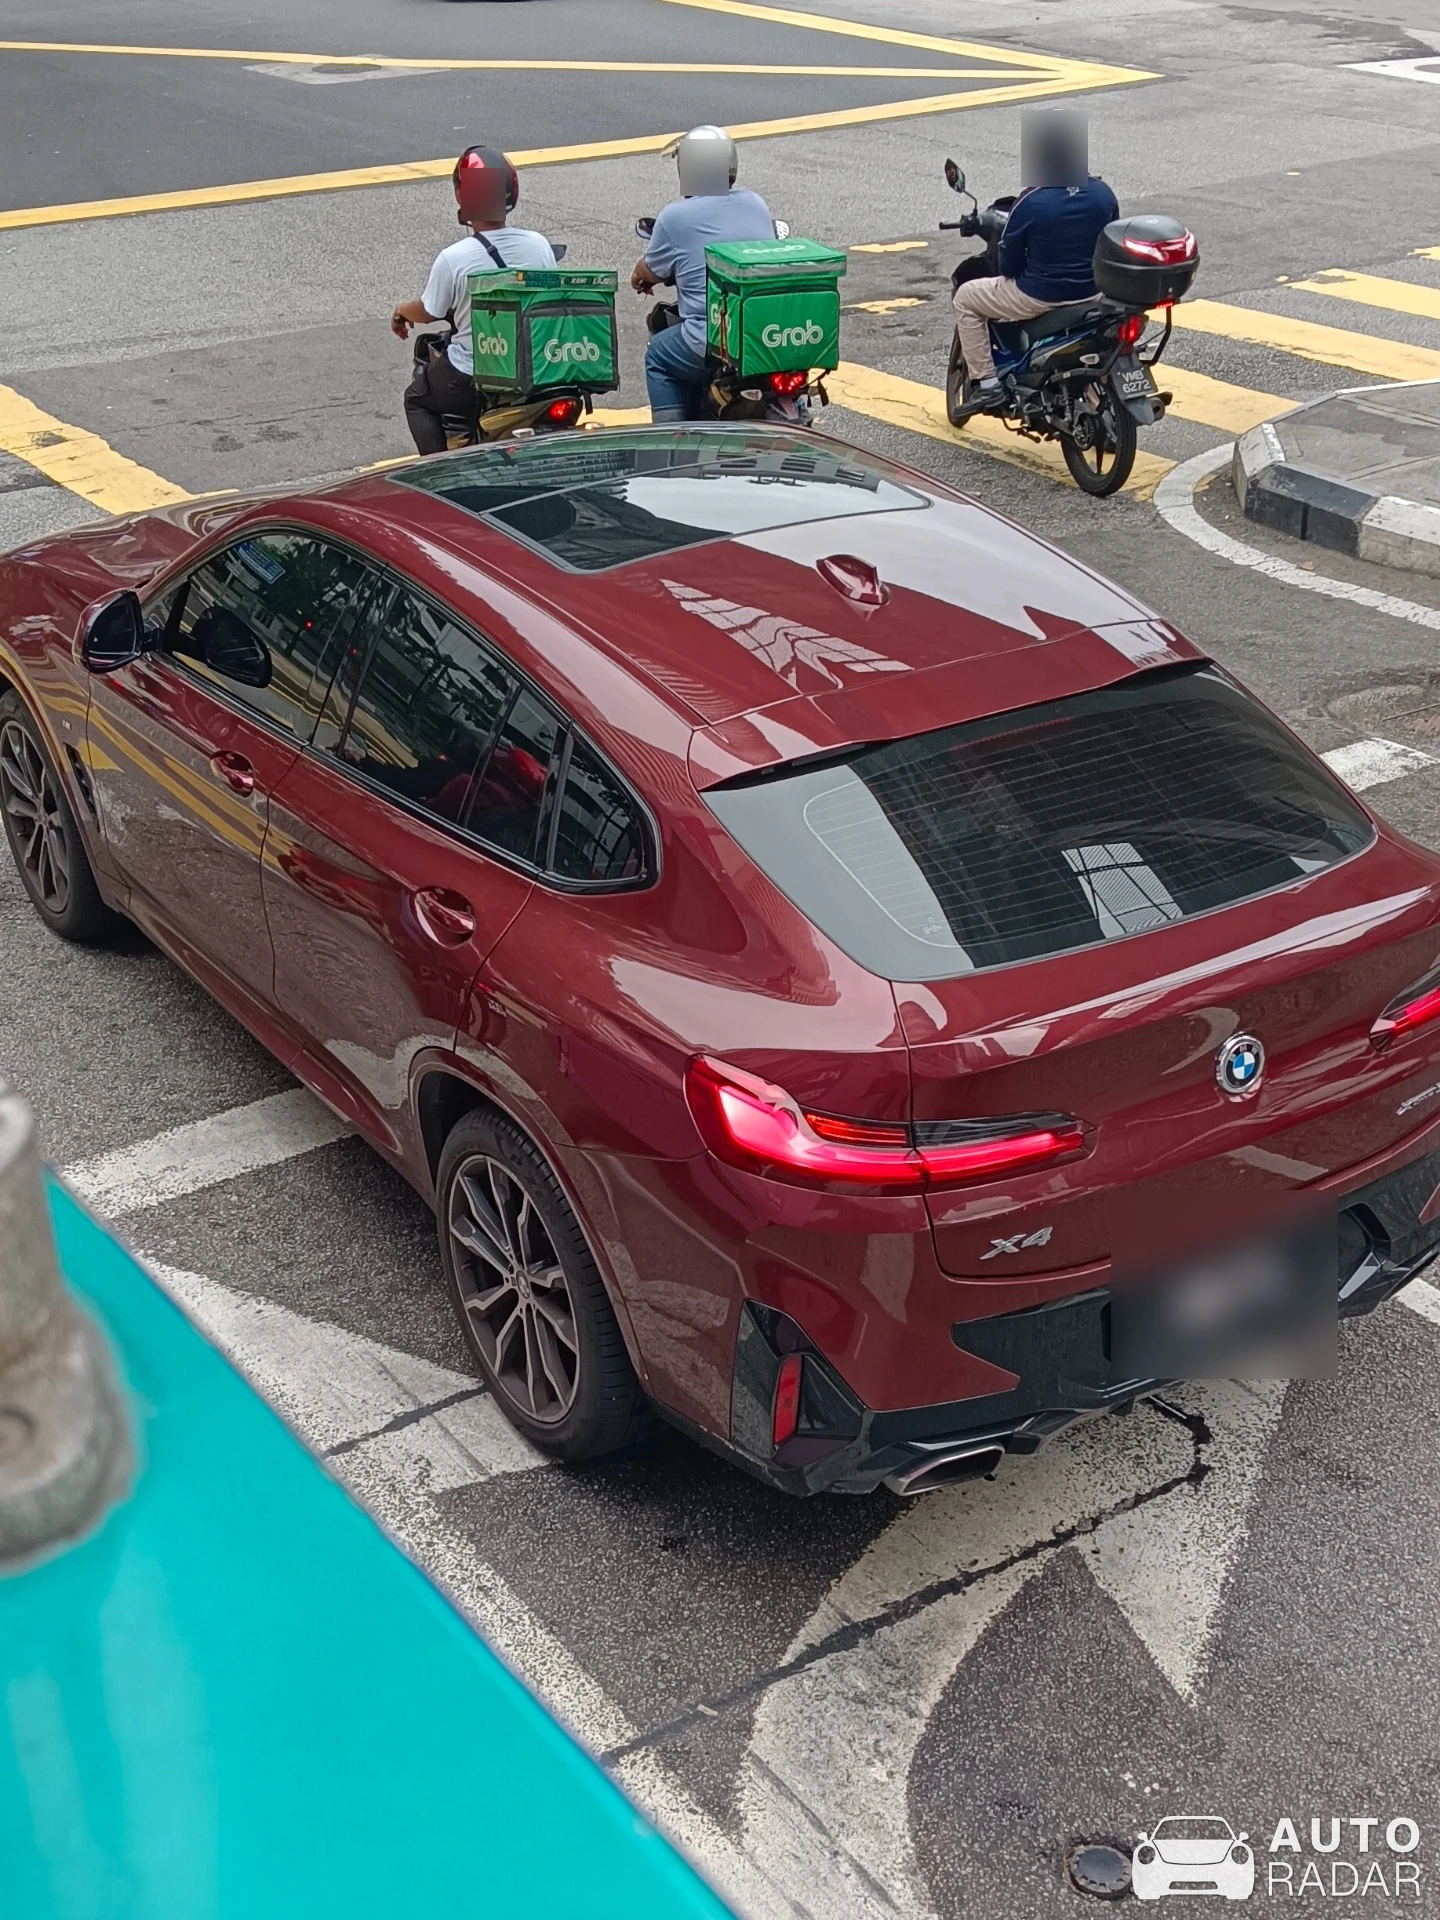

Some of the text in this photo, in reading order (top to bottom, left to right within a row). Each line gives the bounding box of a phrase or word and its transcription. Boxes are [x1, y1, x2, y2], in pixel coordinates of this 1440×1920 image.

[742, 245, 806, 254] Grab
[477, 332, 508, 356] Grab
[761, 319, 824, 348] Grab
[543, 336, 600, 363] Grab
[1122, 370, 1144, 383] VMB
[1122, 379, 1151, 394] 6272
[980, 1226, 1053, 1260] X4
